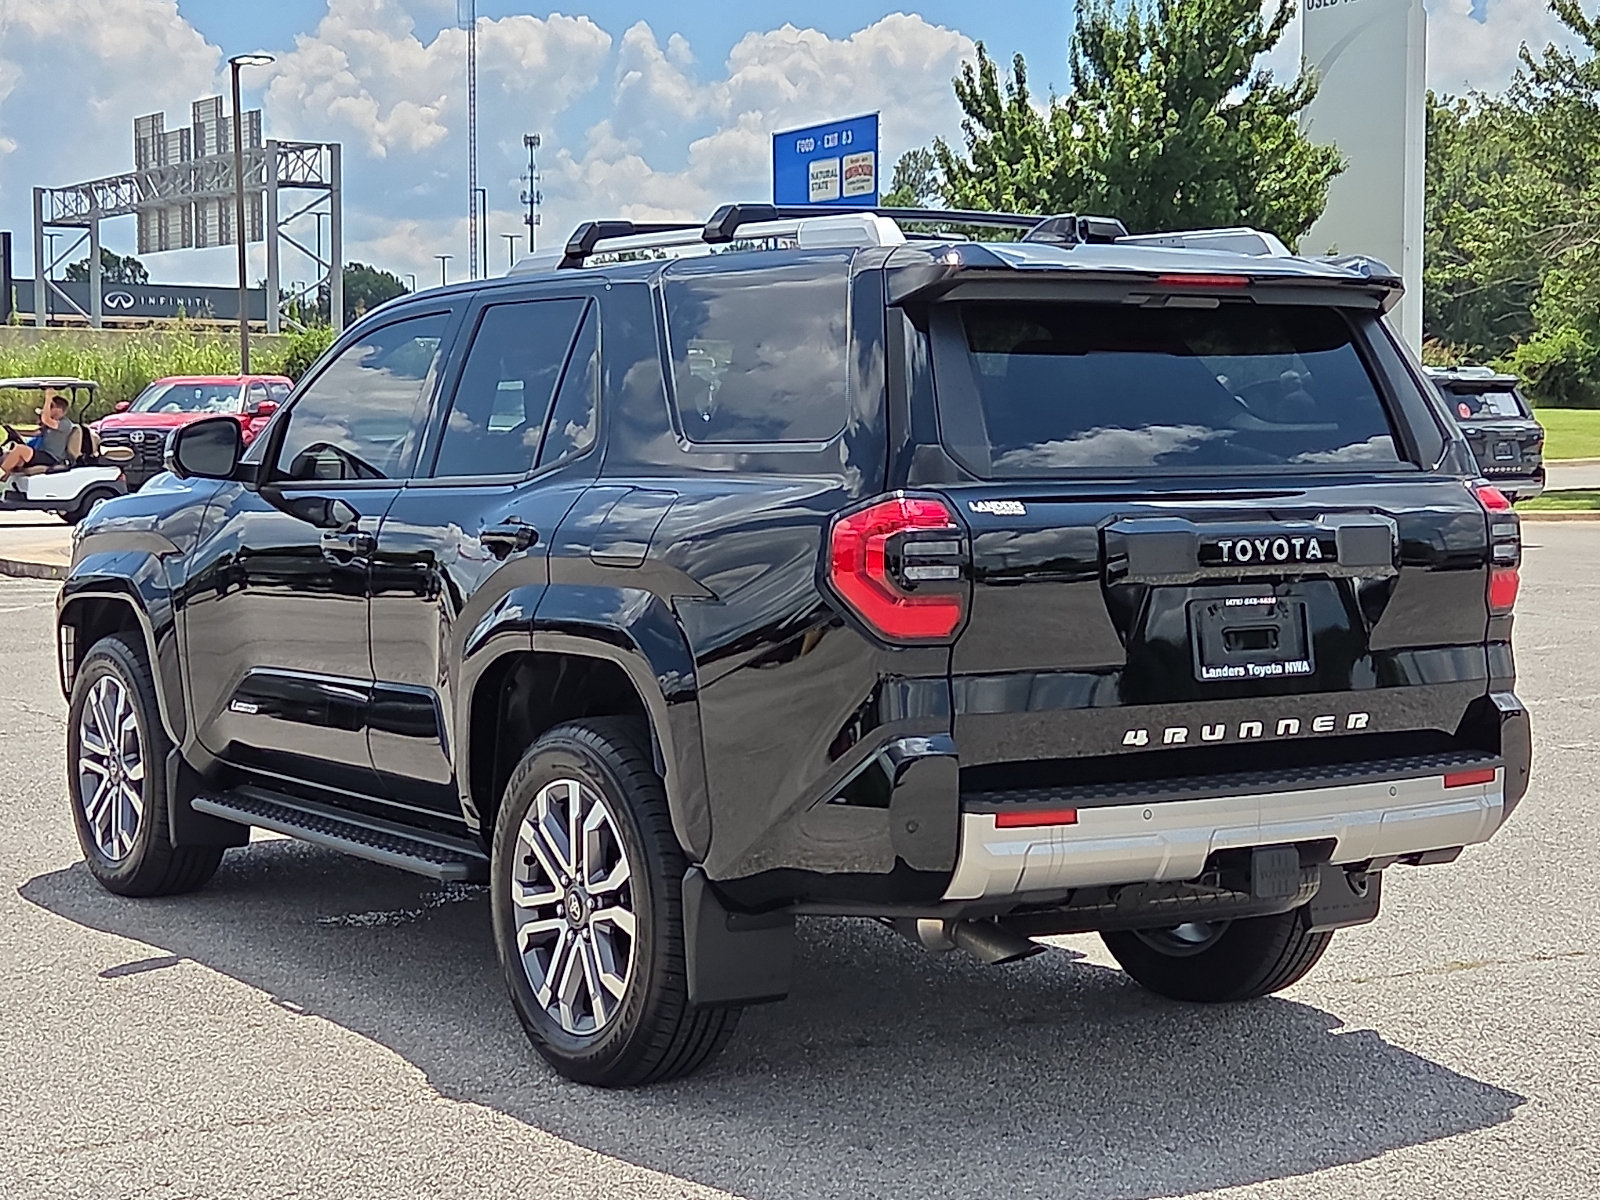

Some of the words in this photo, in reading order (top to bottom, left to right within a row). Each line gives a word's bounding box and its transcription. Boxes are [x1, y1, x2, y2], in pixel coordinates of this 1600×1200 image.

[796, 137, 815, 155] FOOD
[811, 168, 838, 181] NATURAL
[811, 180, 829, 192] STATE
[968, 500, 1025, 512] LANDERS
[1218, 537, 1322, 562] TOYOTA
[1202, 666, 1245, 679] Landers
[1247, 662, 1282, 678] Toyota
[1285, 660, 1310, 674] NWA
[1122, 712, 1370, 747] 4RUNNER
